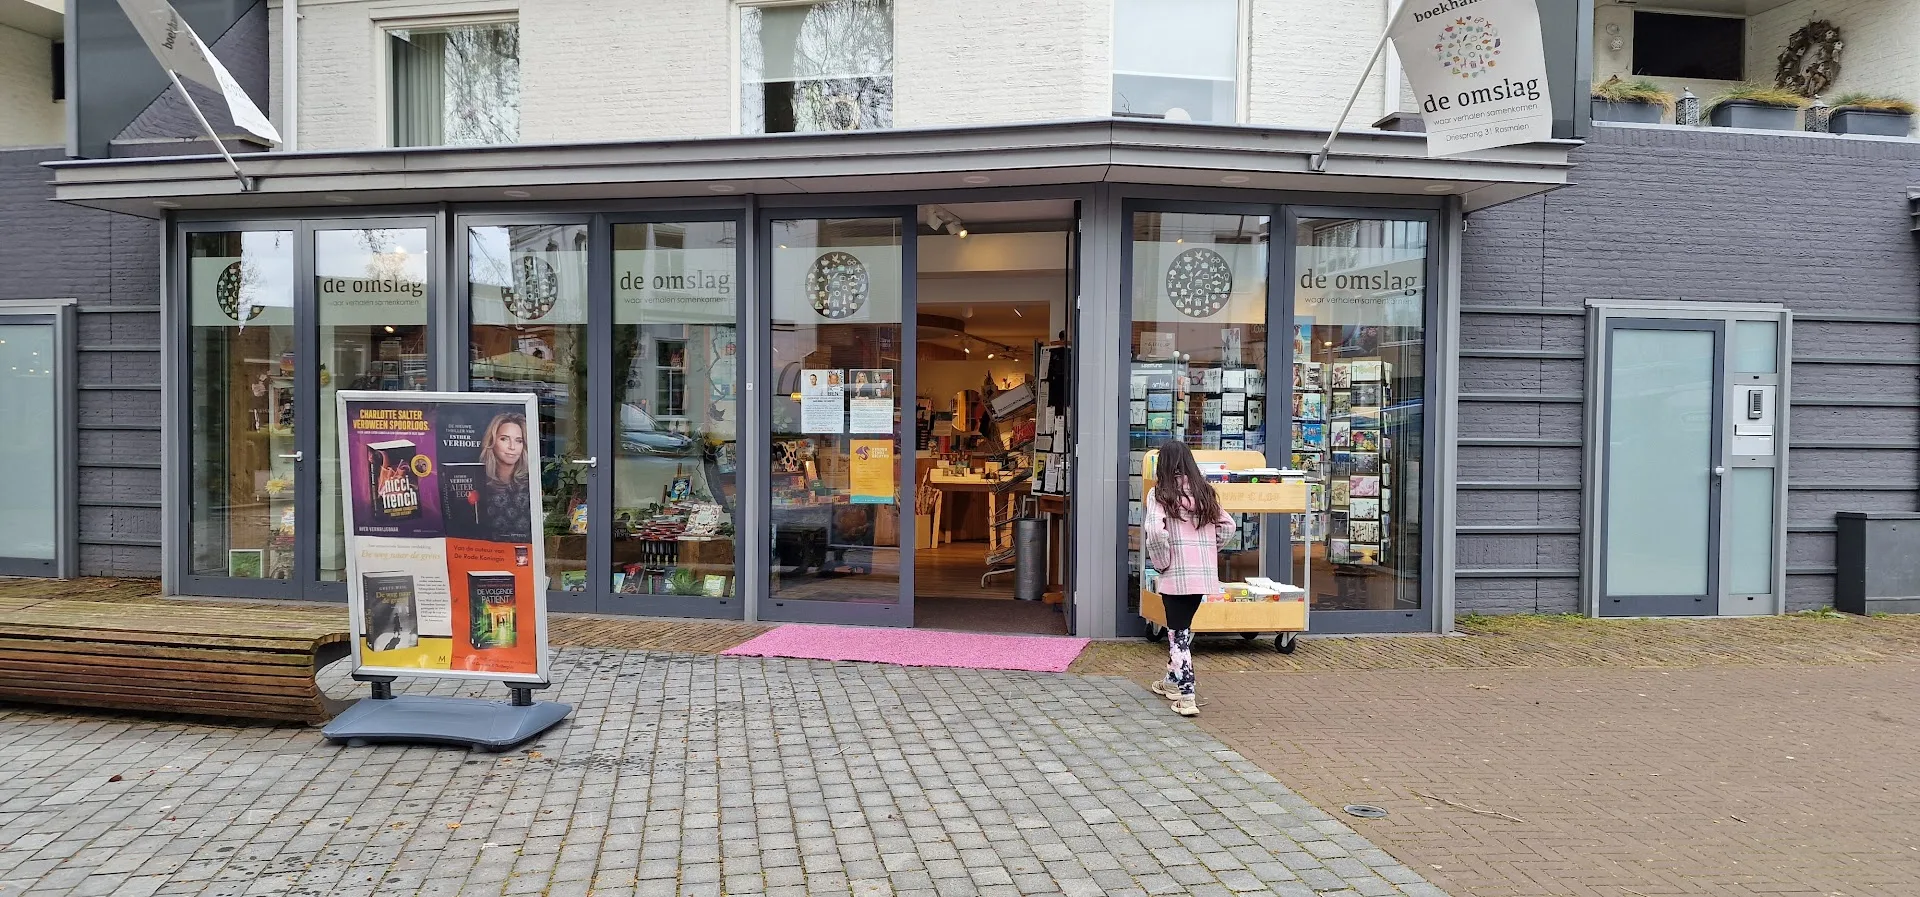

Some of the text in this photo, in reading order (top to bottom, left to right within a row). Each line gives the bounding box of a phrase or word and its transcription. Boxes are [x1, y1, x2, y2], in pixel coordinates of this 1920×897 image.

[1413, 0, 1483, 23] boekhan
[1424, 78, 1541, 113] de omslag
[1433, 103, 1538, 126] waar verhalen samenkomen
[1495, 123, 1530, 134] Rosmalen
[323, 278, 423, 297] de omslag
[620, 270, 731, 294] de omslag
[1300, 268, 1418, 296] de omslag
[360, 409, 423, 420] CHARLOTTE SALTER
[353, 419, 430, 430] VERDWEEN SPOORLOOS.
[443, 439, 481, 448] VERHOEF
[385, 475, 410, 492] nicci
[450, 483, 474, 491] ALTER
[382, 488, 418, 509] french
[480, 555, 505, 563] Koningin
[438, 655, 446, 663] M
